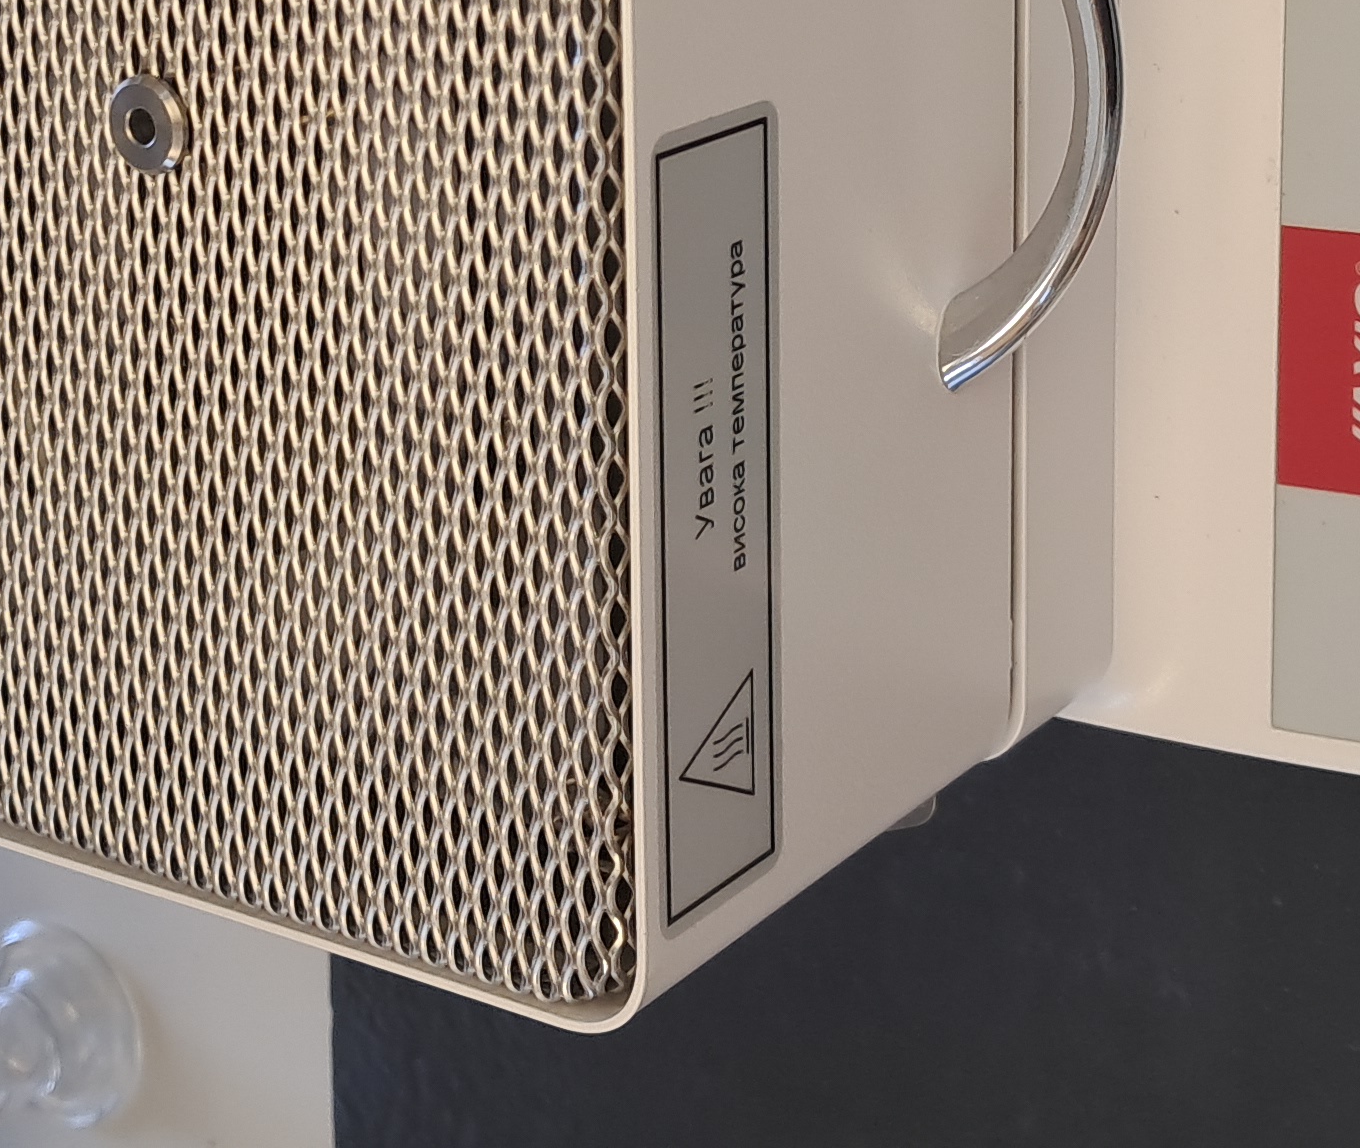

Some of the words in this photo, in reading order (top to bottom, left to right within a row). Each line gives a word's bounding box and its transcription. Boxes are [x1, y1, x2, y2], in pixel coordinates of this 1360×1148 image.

[692, 376, 715, 415] !!!
[727, 238, 747, 455] температура
[693, 423, 716, 541] Увага
[729, 459, 747, 572] висока
